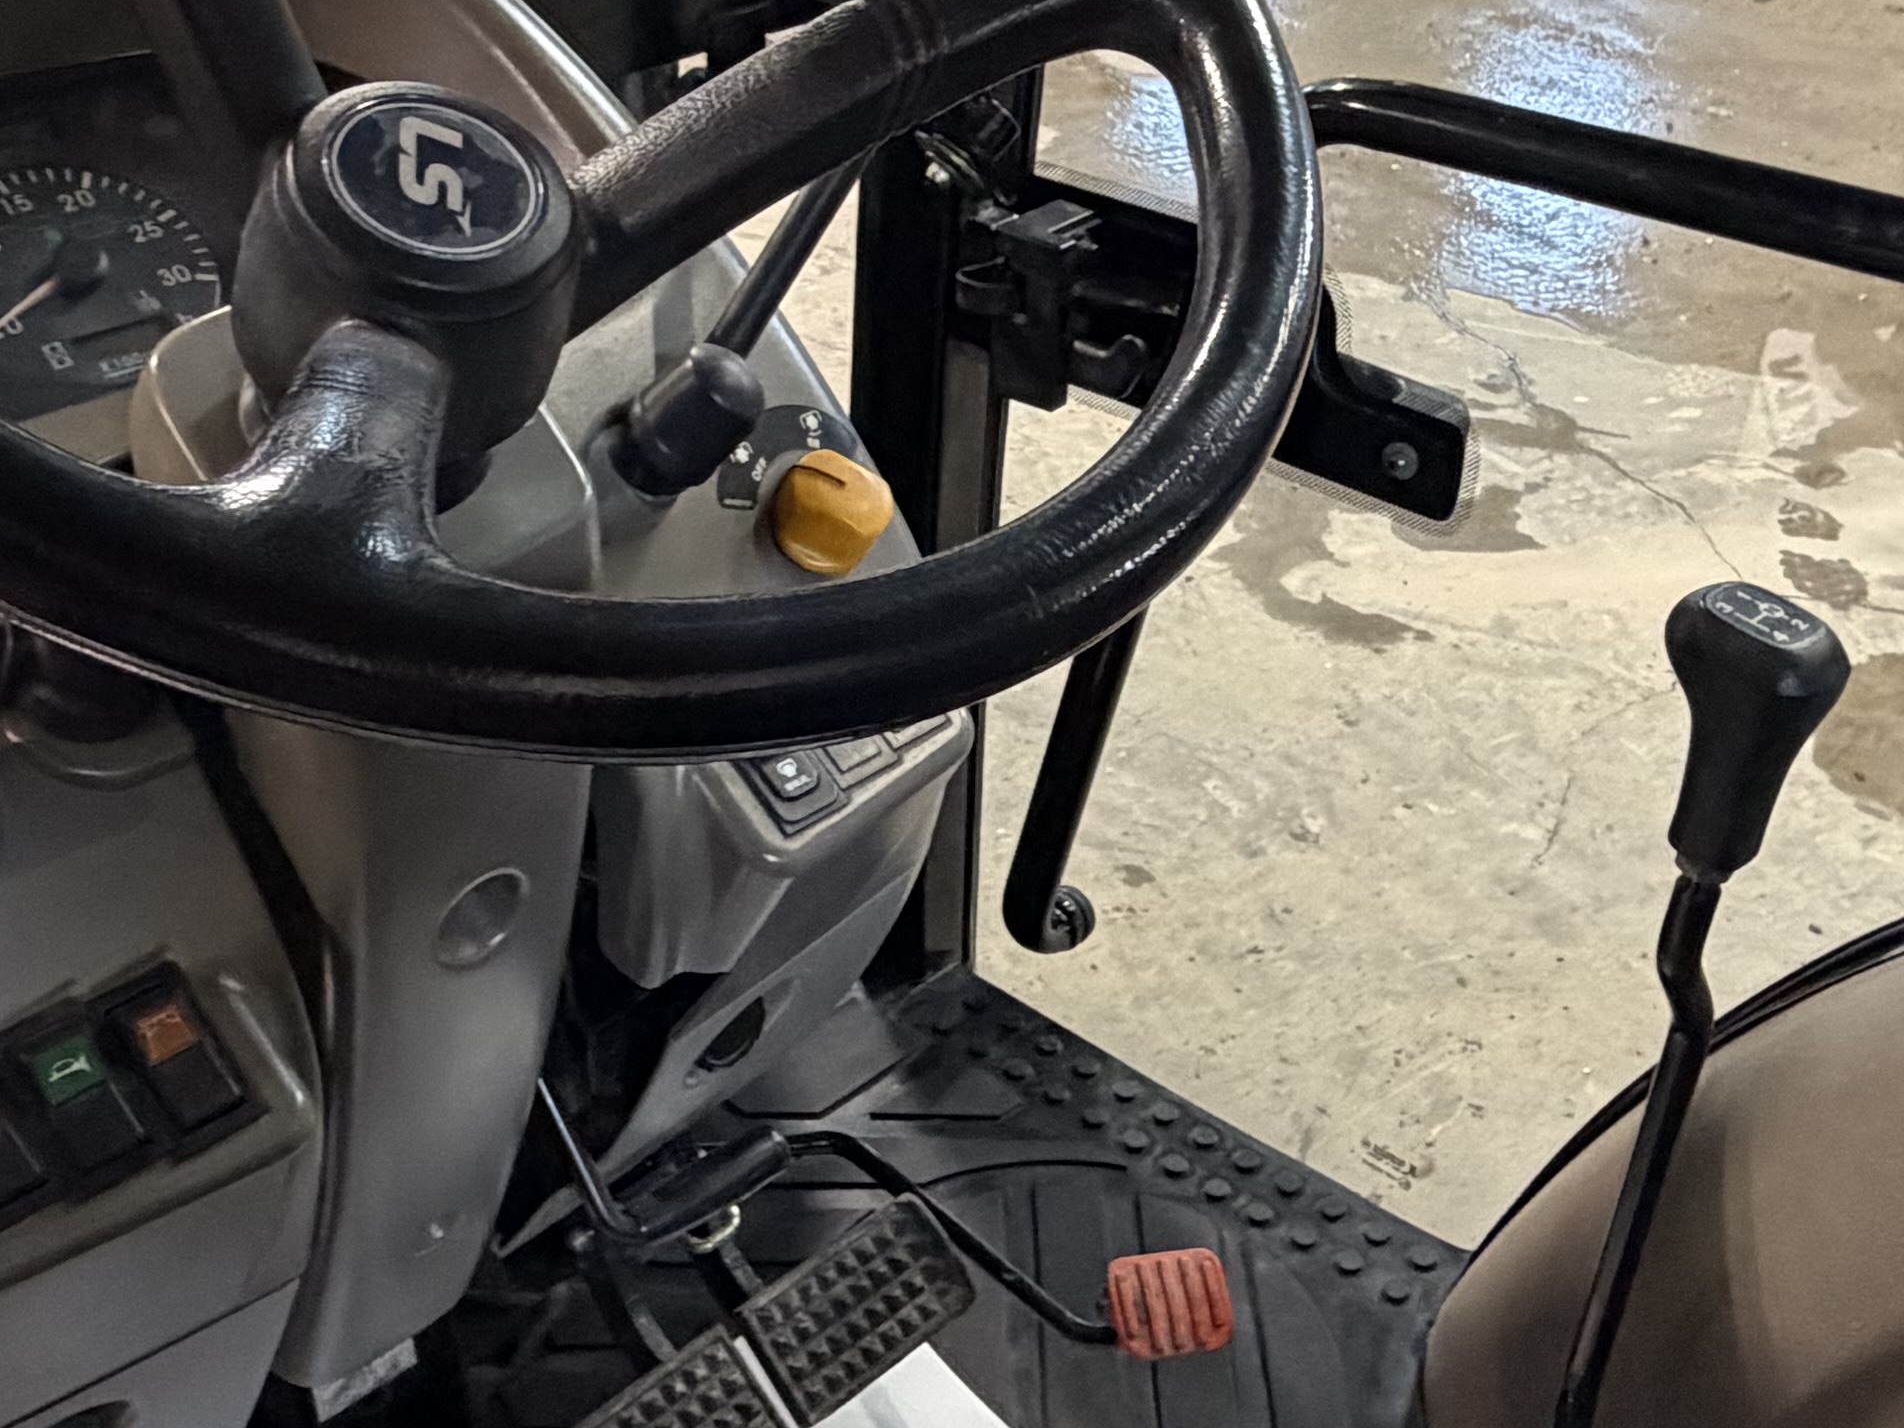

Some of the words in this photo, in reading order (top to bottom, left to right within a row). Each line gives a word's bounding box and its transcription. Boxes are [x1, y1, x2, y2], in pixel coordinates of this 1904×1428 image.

[57, 189, 96, 212] 20
[127, 222, 164, 243] 25
[156, 264, 193, 287] 30
